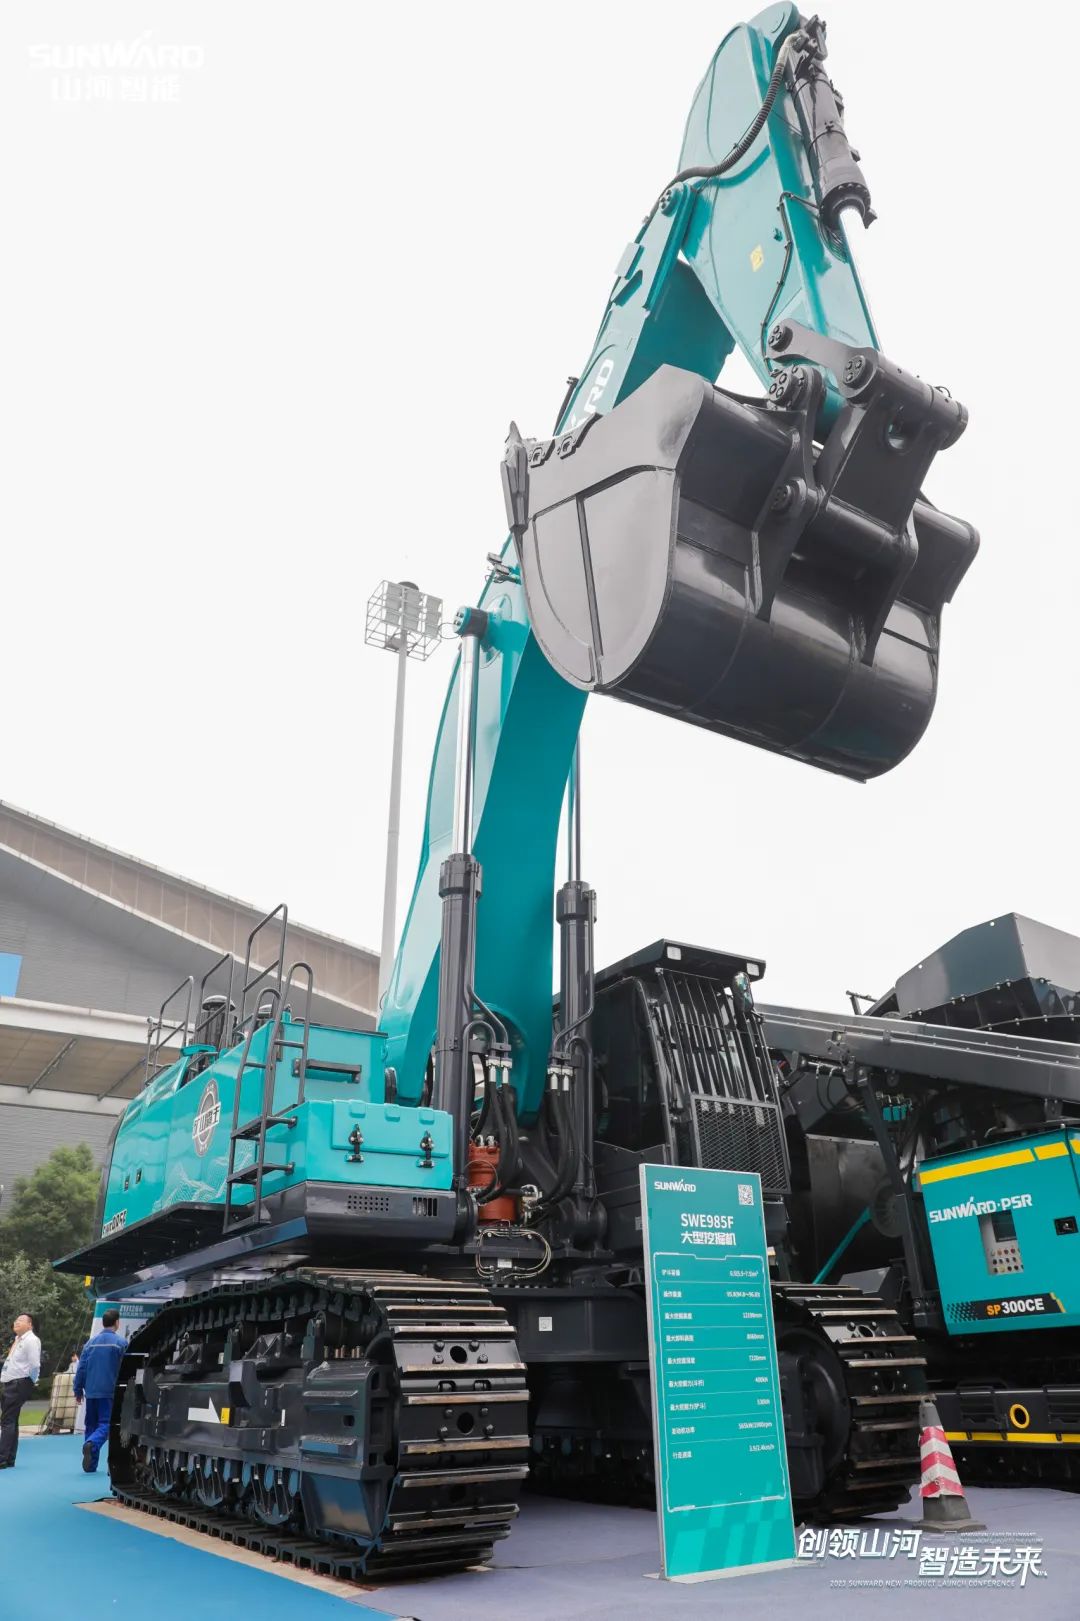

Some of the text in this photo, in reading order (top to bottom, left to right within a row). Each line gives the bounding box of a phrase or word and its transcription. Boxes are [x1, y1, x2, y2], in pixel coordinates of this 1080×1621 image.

[654, 1179, 697, 1193] SUNWARD
[681, 1213, 734, 1229] SWE985F
[681, 1231, 737, 1246] 大型挖掘机
[986, 1298, 1045, 1316] SP300CE
